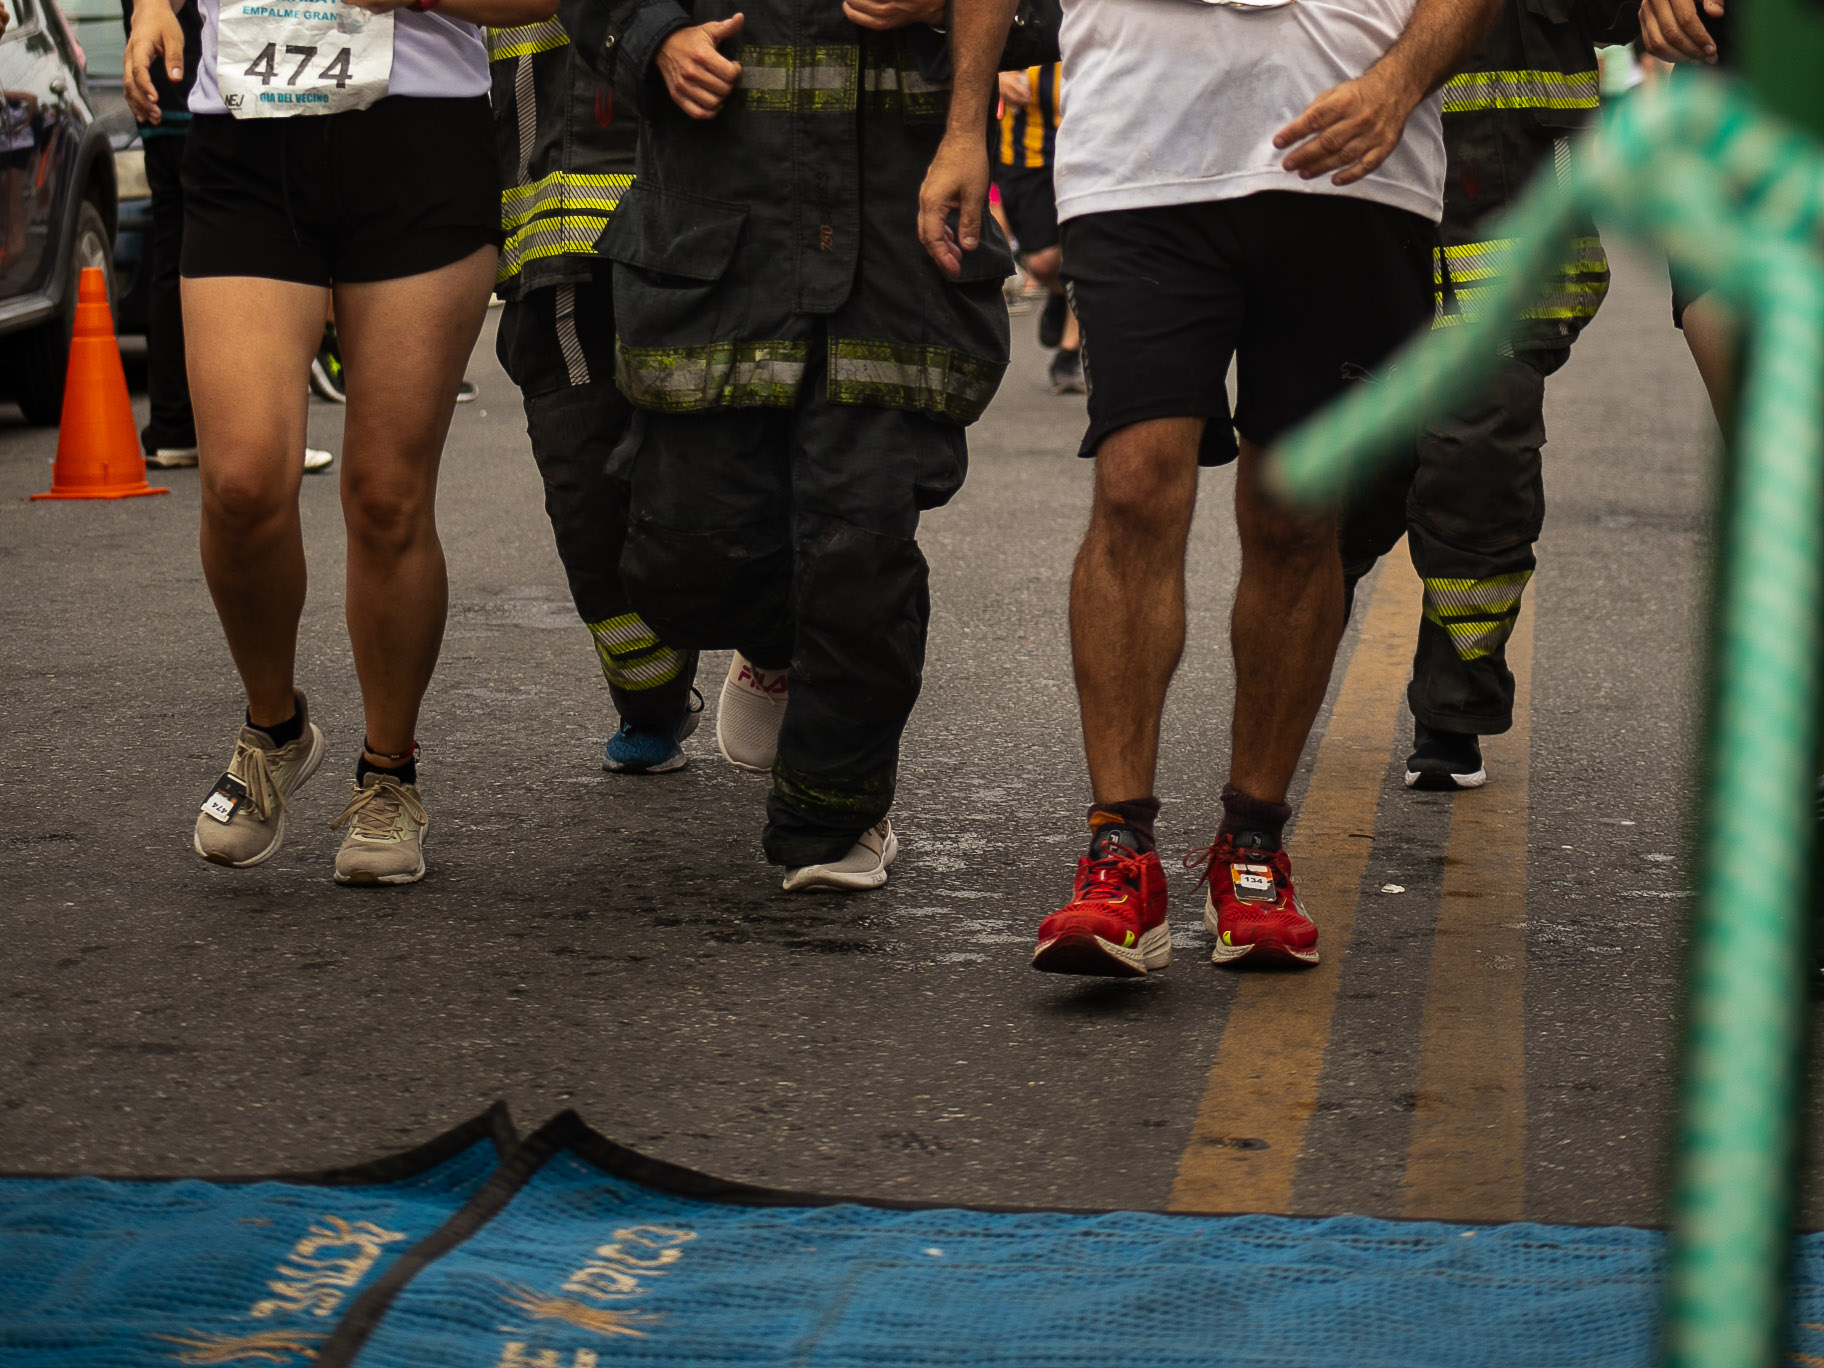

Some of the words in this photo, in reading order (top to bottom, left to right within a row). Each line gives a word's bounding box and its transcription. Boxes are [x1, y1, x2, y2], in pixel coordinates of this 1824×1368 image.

[243, 5, 300, 19] EMPALME
[303, 11, 338, 21] GRAN
[244, 42, 353, 89] 474
[260, 93, 275, 103] DIA
[277, 93, 293, 103] DEL
[295, 93, 329, 104] VECINO
[212, 802, 227, 814] 474
[1244, 876, 1263, 884] 134
